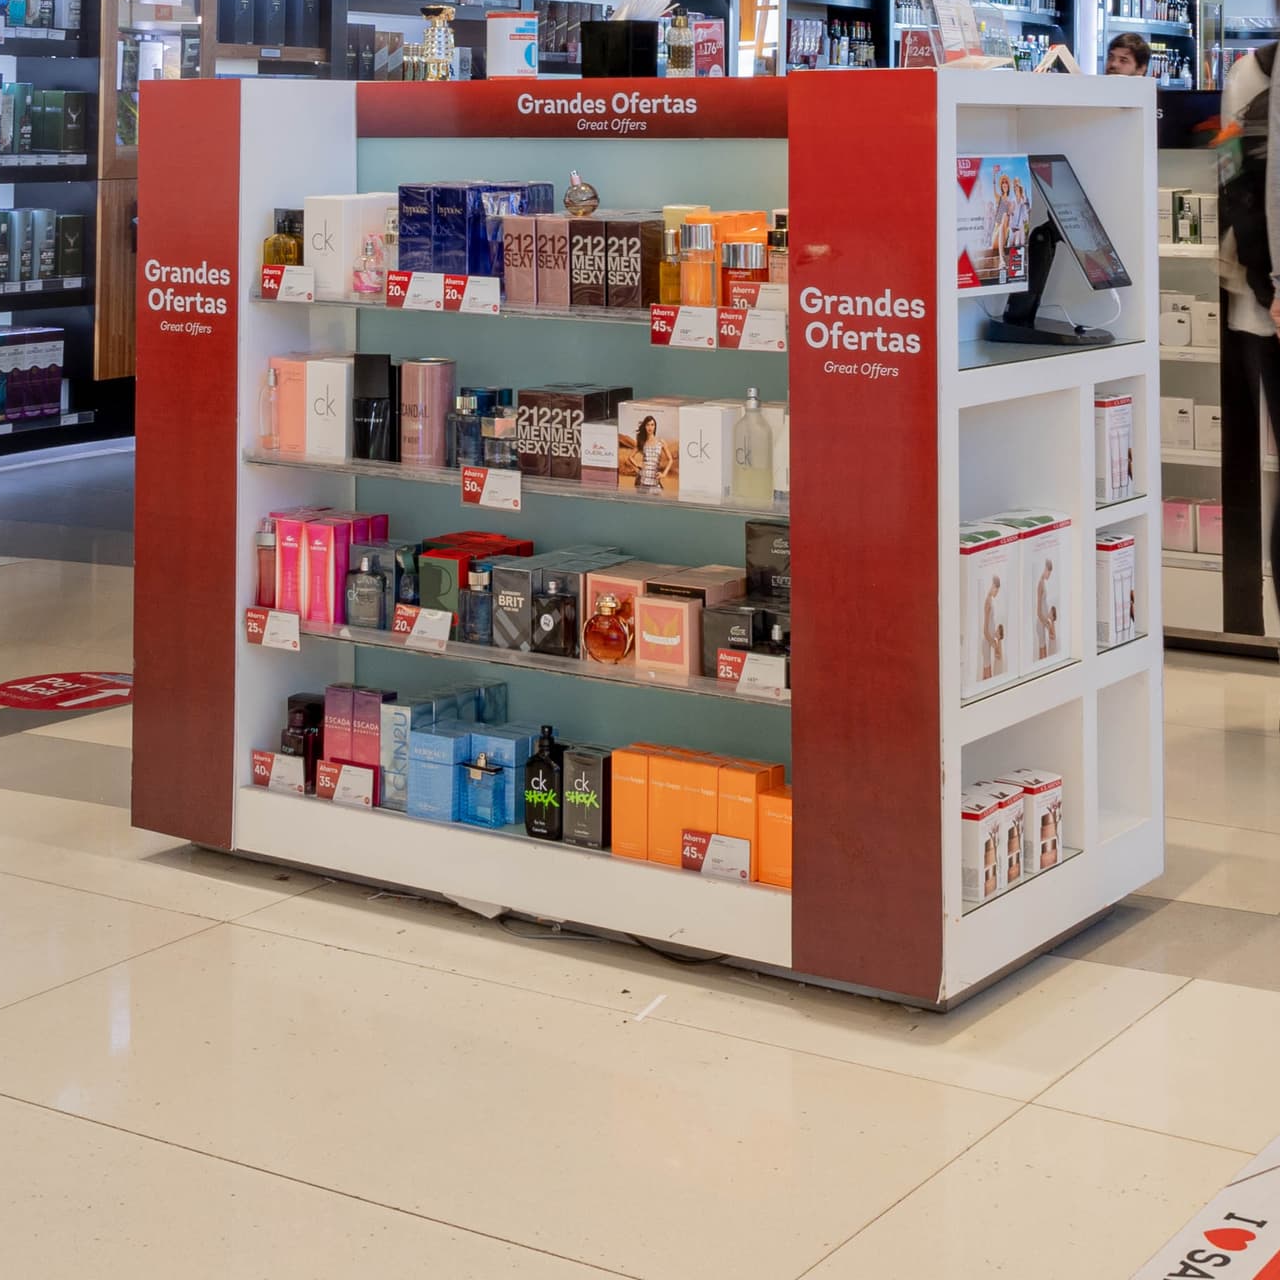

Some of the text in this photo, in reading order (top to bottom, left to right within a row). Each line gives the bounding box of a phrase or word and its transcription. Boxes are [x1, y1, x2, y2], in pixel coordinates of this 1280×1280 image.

[517, 92, 697, 114] Grandes Ofertas
[577, 118, 647, 133] Great Offers
[312, 218, 335, 252] ck
[504, 234, 533, 254] 212
[538, 236, 568, 255] 212
[572, 235, 605, 257] 212
[608, 237, 641, 258] 212
[504, 253, 533, 268] SEXY
[538, 254, 568, 270] SEXY
[572, 256, 604, 271] MEN
[608, 257, 641, 272] MEN
[144, 259, 231, 285] Grandes
[389, 274, 408, 283] Ahorra
[572, 270, 604, 284] SEXY
[608, 271, 640, 286] SEXY
[445, 278, 464, 286] Ahorra
[389, 285, 405, 296] 20%
[445, 289, 462, 300] 20%
[732, 285, 755, 295] Ahorra
[148, 288, 227, 315] Ofertas
[799, 286, 925, 318] Grandes
[652, 308, 674, 317] Ahorra
[720, 312, 743, 321] Ahorra
[160, 320, 212, 336] Great Offers
[652, 320, 672, 333] 45%
[721, 324, 741, 337] 40%
[805, 321, 921, 354] Ofertas
[824, 360, 899, 379] Great Offers
[314, 384, 336, 418] ck
[518, 406, 551, 428] 212
[551, 408, 584, 430] 212
[518, 426, 551, 442] MEN
[551, 428, 582, 443] MEN
[518, 440, 550, 455] SEXY
[552, 443, 583, 458] SEXY
[687, 429, 711, 460] ck
[464, 470, 484, 479] Ahorra
[464, 481, 481, 493] 30%
[498, 594, 524, 609] BRIT
[247, 623, 263, 635] 25%
[719, 653, 741, 663] Ahorra
[719, 665, 739, 680] 25%
[35, 677, 87, 689] Por
[325, 715, 350, 726] ESCADA
[353, 720, 379, 730] ESCADA
[320, 765, 337, 773] Ahorra
[319, 775, 335, 787] 35%
[531, 769, 548, 792] ck
[574, 772, 589, 793] ck
[683, 833, 706, 844] Ahorra
[683, 847, 703, 860] 45%
[1163, 1212, 1268, 1280] I SA
